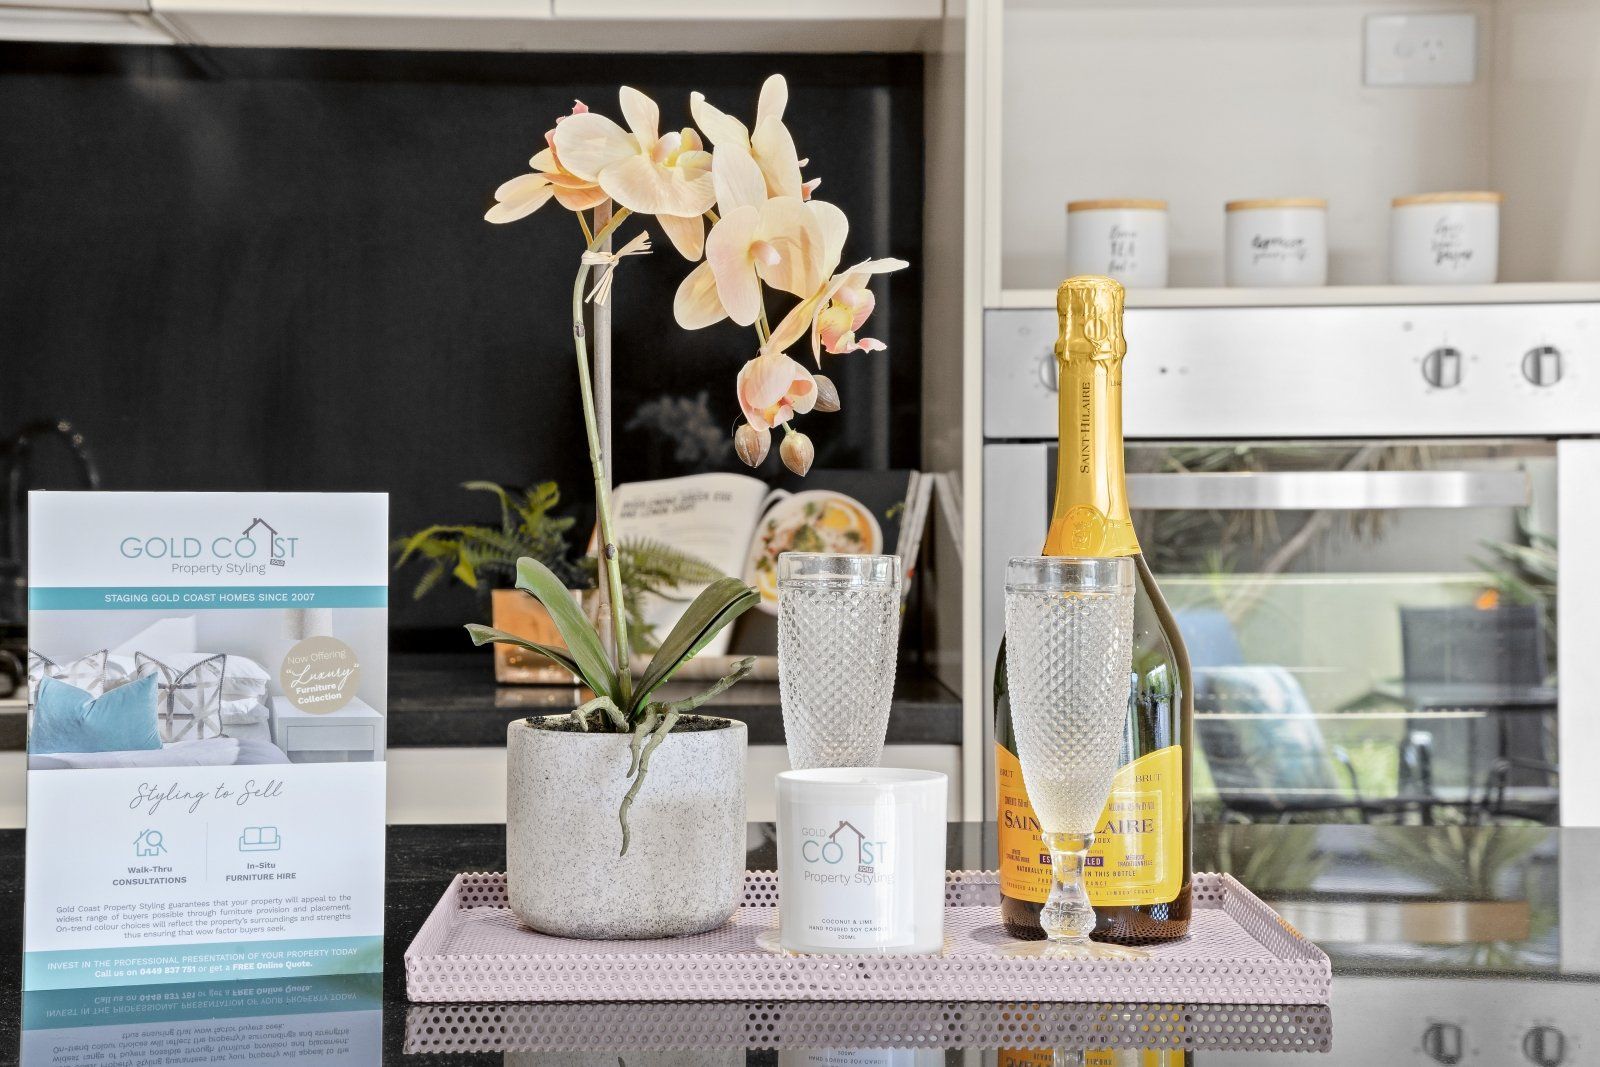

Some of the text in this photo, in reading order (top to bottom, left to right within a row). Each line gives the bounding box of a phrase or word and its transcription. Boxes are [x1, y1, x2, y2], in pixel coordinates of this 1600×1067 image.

[120, 537, 202, 559] GOLD
[172, 563, 266, 576] Property Styling
[104, 593, 315, 603] STAGING GOLD COAST HOMES SINCE 2007
[287, 650, 347, 664] Now Offering
[296, 684, 336, 694] Furniture
[298, 692, 342, 704] Collection
[1135, 774, 1162, 783] BRUT
[130, 780, 284, 816] Styling to Sell
[801, 828, 826, 837] GOLD
[128, 866, 172, 874] Walk-Thru
[246, 862, 276, 870] In-Situ
[112, 876, 187, 886] CONSULTATIONS
[226, 872, 297, 882] FURNITURE HIRE
[805, 871, 850, 885] Property
[56, 905, 75, 913] Gold
[77, 904, 100, 912] Coast
[103, 902, 137, 914] Property
[139, 901, 165, 912] Styling
[168, 899, 210, 911] guarantees
[213, 899, 229, 907] that
[231, 899, 248, 908] your
[251, 896, 283, 908] property
[301, 894, 326, 905] appeal
[328, 894, 337, 902] to
[339, 893, 351, 901] the
[56, 903, 351, 924] widest range of buyers possible through furniture provision and placement.
[56, 912, 351, 932] On-trend colour choices will reflect the property’s surroundings and strengths
[124, 930, 141, 938] thus
[143, 929, 176, 940] ensuring
[178, 928, 194, 936] that
[215, 926, 237, 935] factor
[240, 925, 264, 936] buyers
[267, 924, 286, 932] seek.
[48, 948, 358, 970] INVEST IN THE PROFESSIONAL PRESENTATION OF YOUR PROPERTY TODAY
[94, 969, 111, 978] Call
[140, 967, 162, 975] 0449
[164, 966, 180, 974] 837
[182, 965, 196, 973] 751
[209, 964, 223, 974] get
[233, 963, 254, 971] FREE
[256, 961, 283, 970] Online
[285, 960, 313, 971] Quote.
